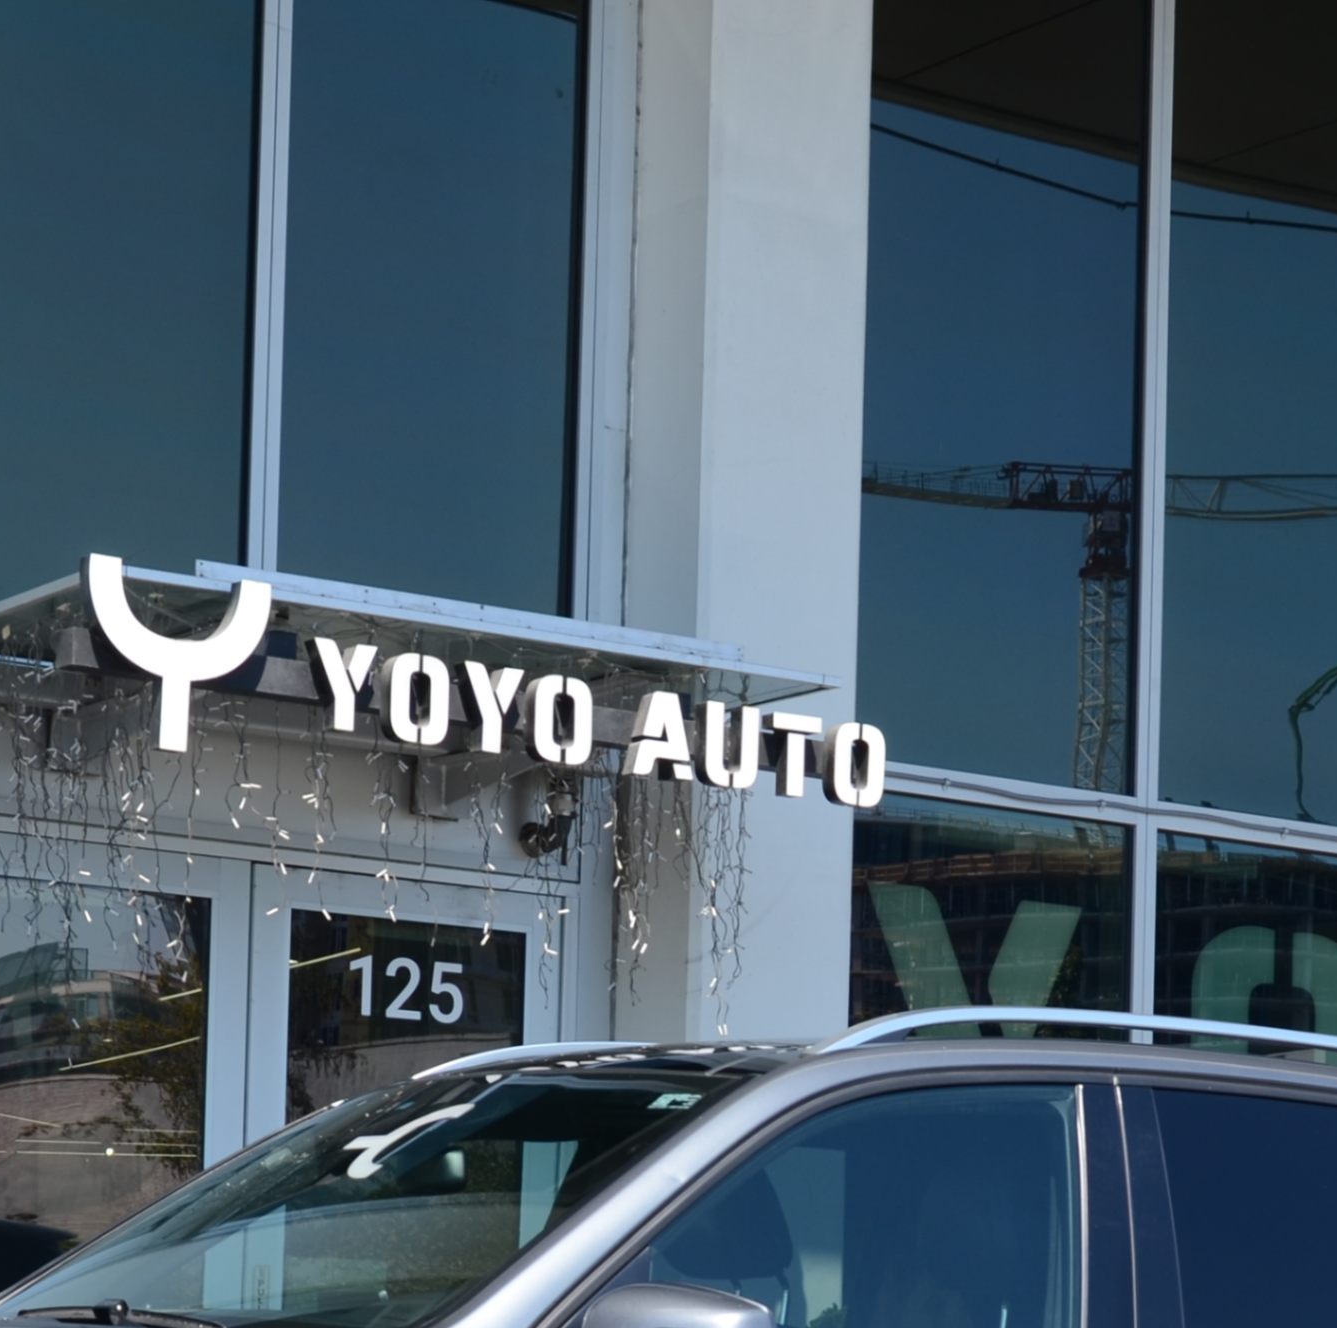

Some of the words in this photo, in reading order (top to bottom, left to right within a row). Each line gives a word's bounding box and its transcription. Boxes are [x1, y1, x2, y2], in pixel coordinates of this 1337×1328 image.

[312, 637, 593, 765] YOYO
[628, 691, 886, 807] AUTO
[349, 953, 464, 1024] 125
